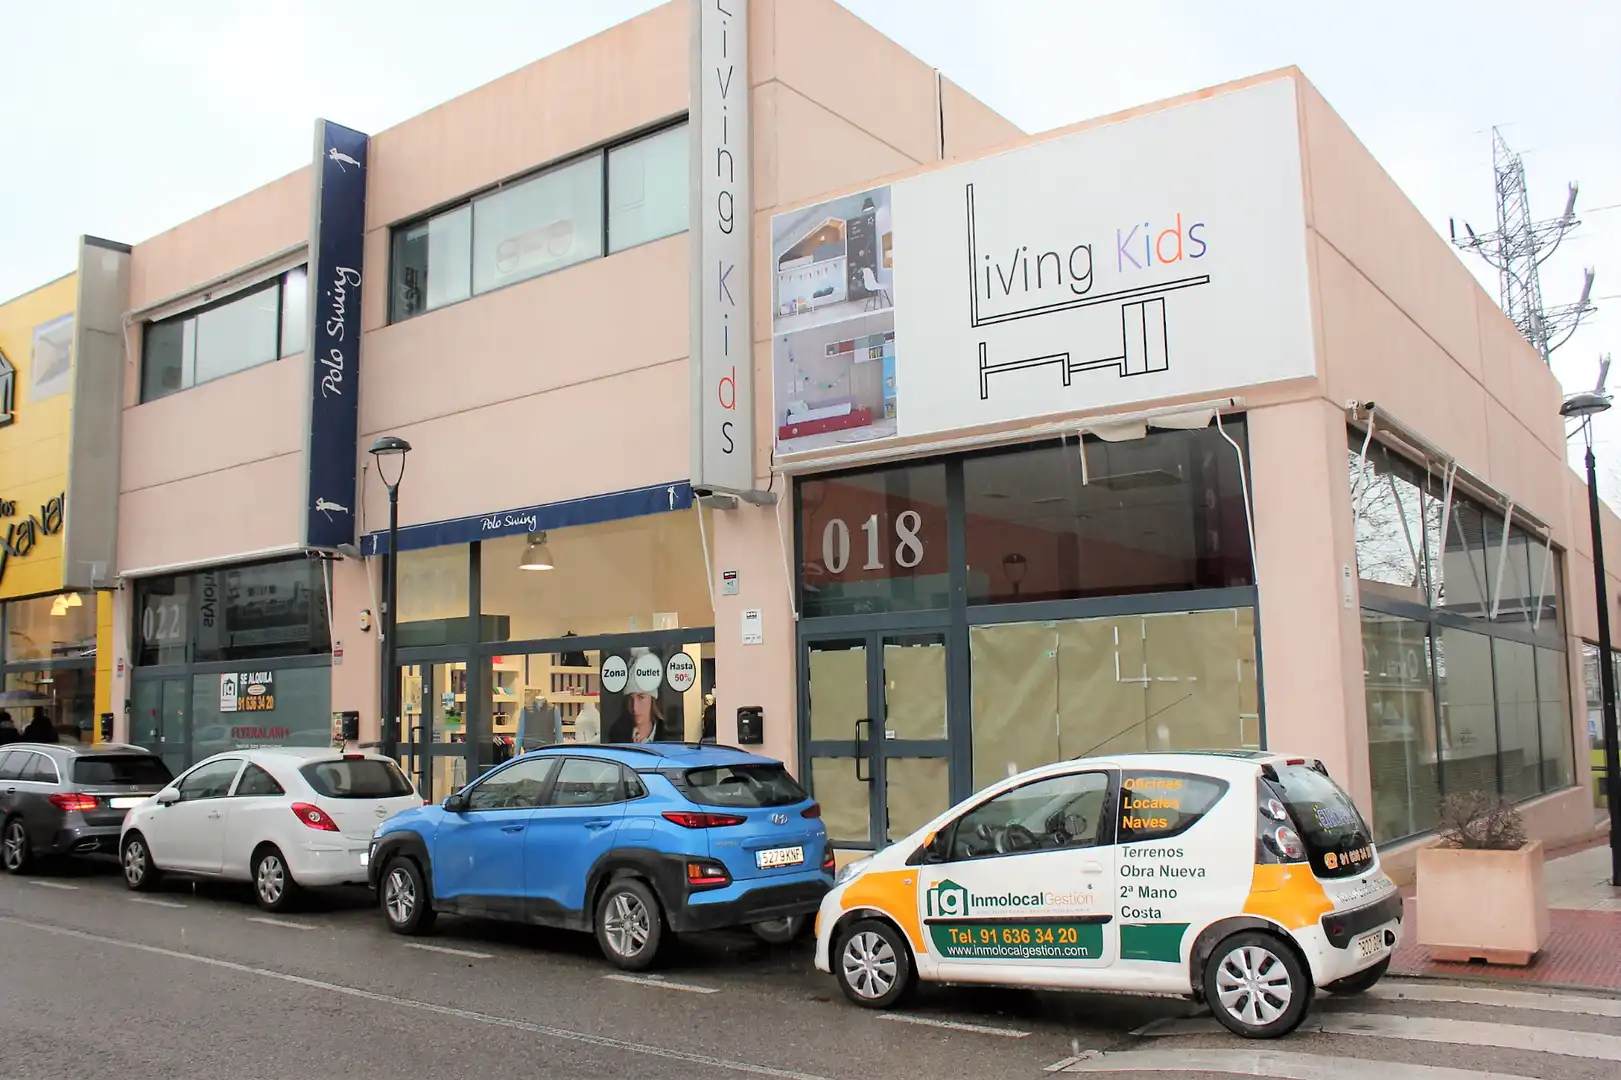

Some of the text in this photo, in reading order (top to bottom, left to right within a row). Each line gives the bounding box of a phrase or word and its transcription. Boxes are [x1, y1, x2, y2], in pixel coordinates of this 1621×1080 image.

[966, 183, 1207, 328] Living Kids
[321, 266, 362, 398] Polo Swing
[718, 260, 736, 454] Kids
[480, 512, 537, 532] Polo Swing
[822, 510, 924, 574] 018
[143, 603, 180, 641] 022
[603, 669, 626, 678] Zona
[636, 668, 660, 677] Outlet
[669, 662, 693, 671] Hasta
[240, 671, 273, 685] SE ALQUILA
[1124, 778, 1182, 791] Oficinas
[1124, 797, 1179, 809] Locales
[1122, 816, 1168, 829] Naves
[1122, 846, 1184, 858] Terrenos
[1120, 865, 1206, 878] Obra Nueva
[1138, 885, 1177, 899] Mano
[1121, 906, 1162, 919] Costa
[949, 928, 1077, 944] Tel. 91 636 34 20
[947, 944, 1088, 958] www.inmolocalgestion.com
